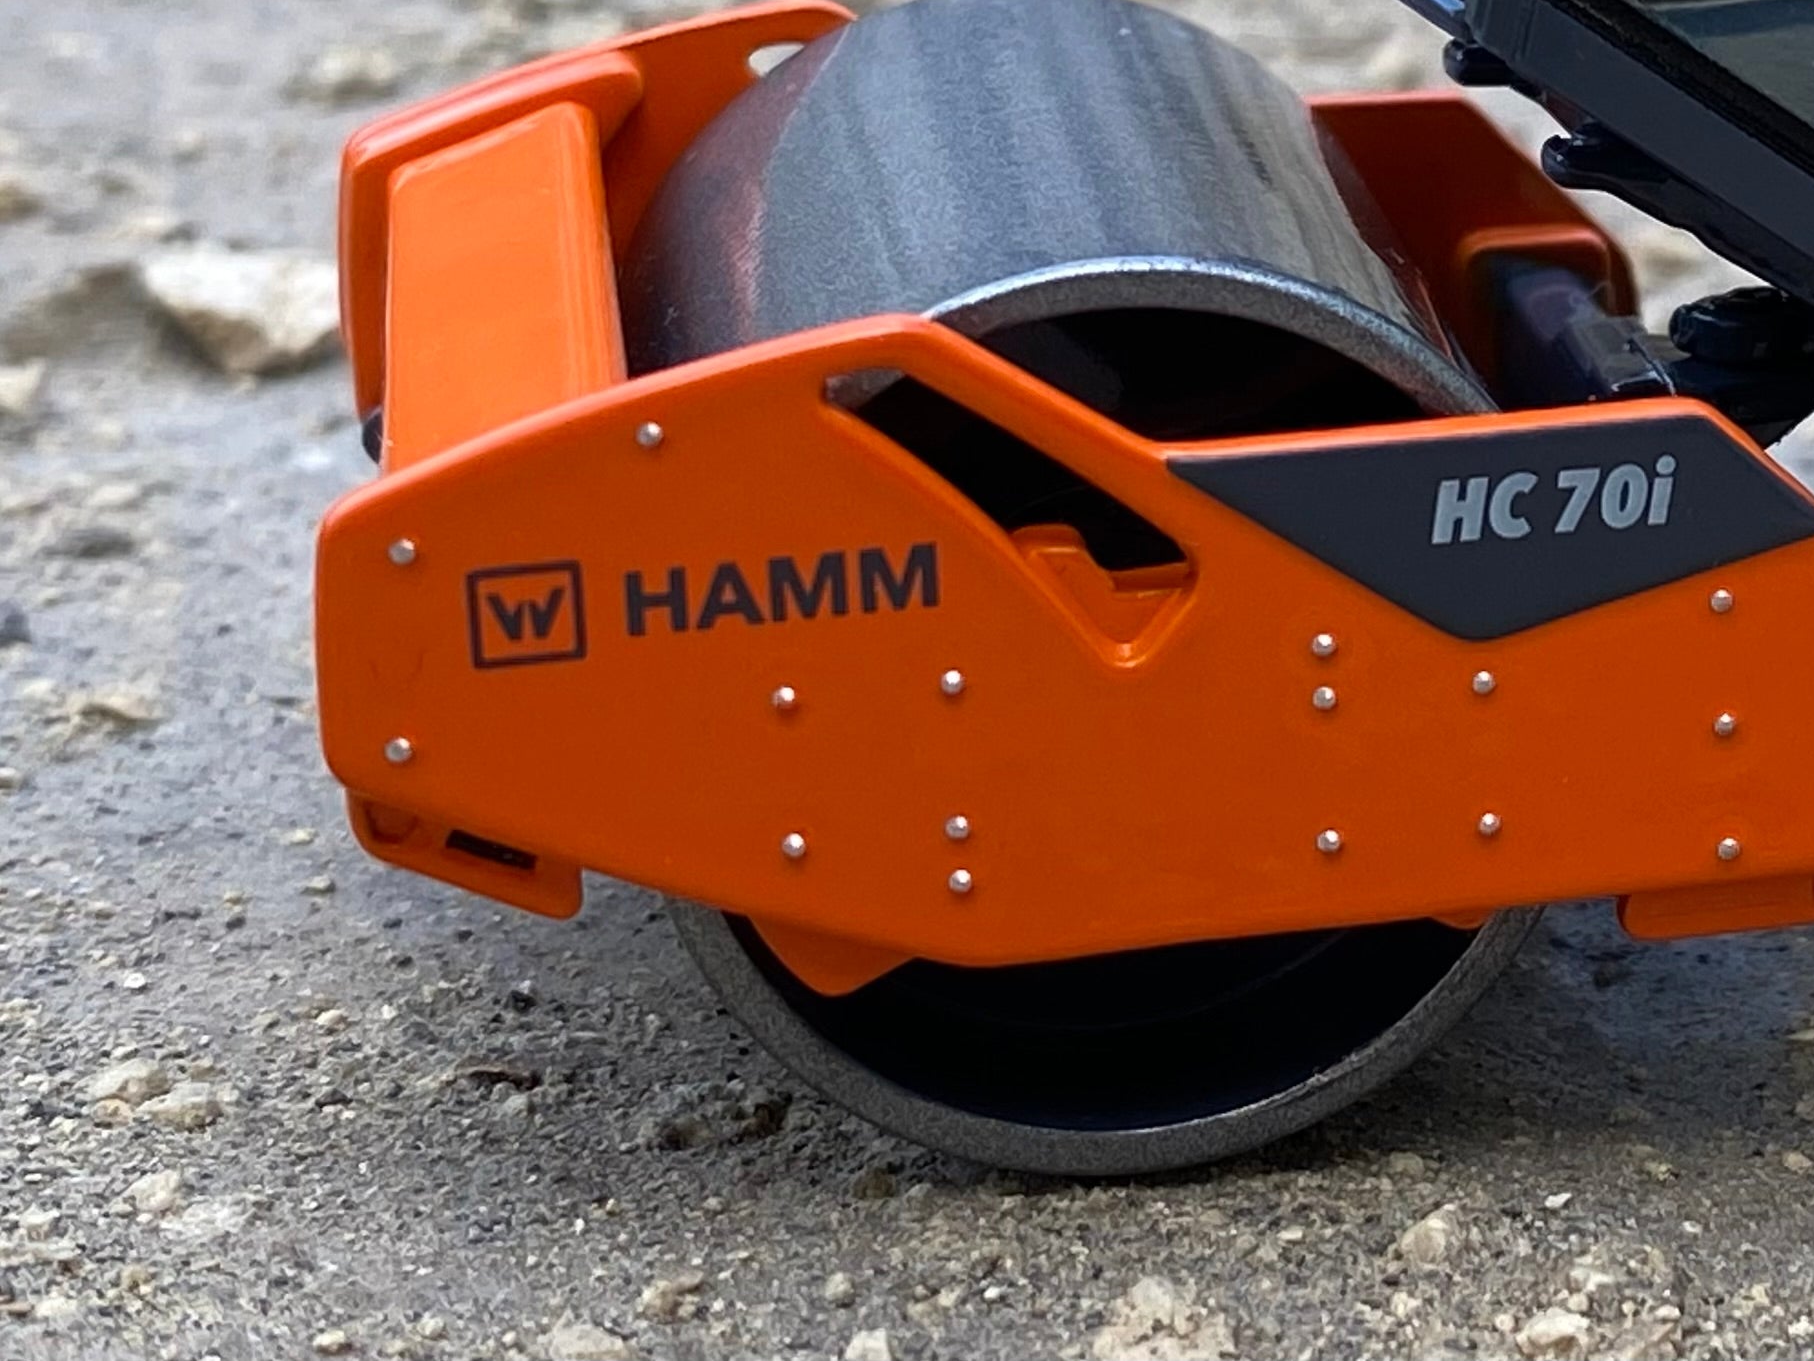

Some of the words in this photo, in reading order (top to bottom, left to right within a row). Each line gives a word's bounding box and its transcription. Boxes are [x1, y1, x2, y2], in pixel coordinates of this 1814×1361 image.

[1431, 471, 1539, 544] HC
[1554, 454, 1677, 533] 70i
[624, 541, 940, 636] HAMM
